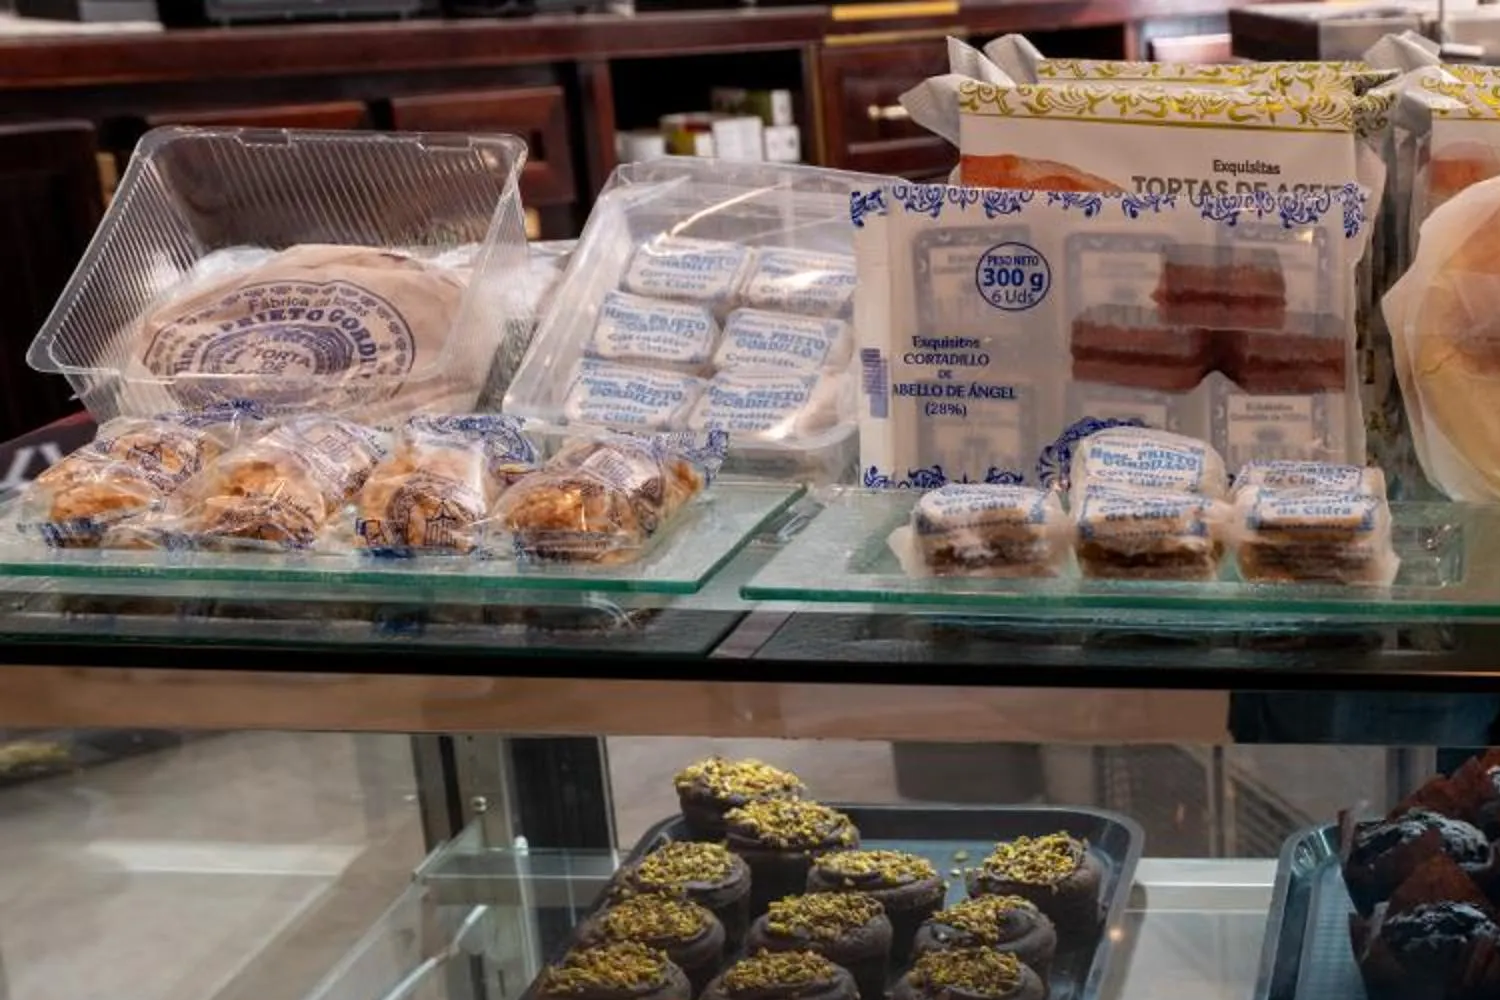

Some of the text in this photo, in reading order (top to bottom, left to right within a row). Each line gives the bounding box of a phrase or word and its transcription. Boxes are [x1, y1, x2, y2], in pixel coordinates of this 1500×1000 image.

[1213, 160, 1281, 175] Exquisitas
[1132, 175, 1229, 198] TORTAS
[983, 268, 1044, 292] 300 g
[992, 290, 1001, 303] 6
[904, 353, 990, 366] CORTADILLO
[892, 382, 1017, 399] ABELLO DE ÁNGEL
